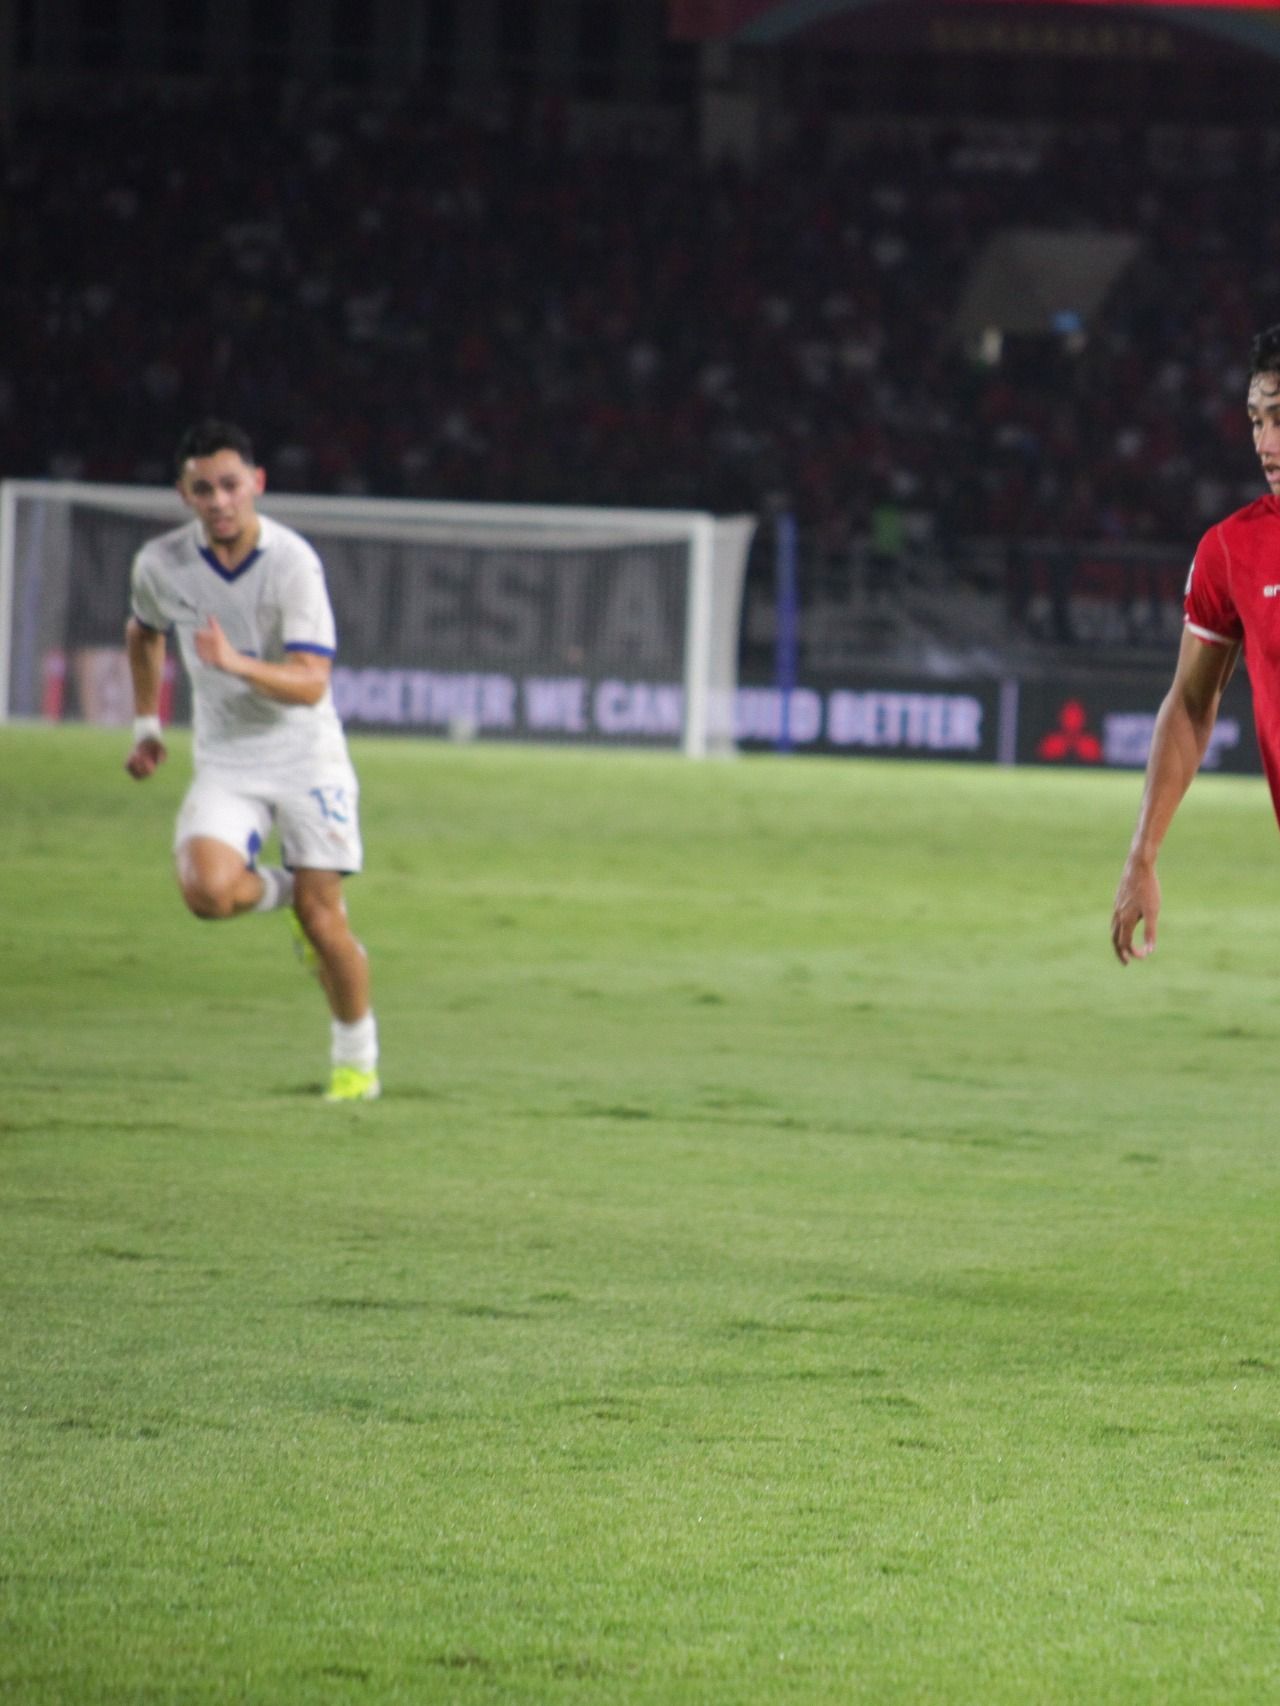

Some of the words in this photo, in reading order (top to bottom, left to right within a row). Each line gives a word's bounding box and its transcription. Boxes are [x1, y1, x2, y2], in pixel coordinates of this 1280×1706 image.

[334, 667, 517, 728] OGETHER
[525, 676, 588, 732] WE
[828, 689, 983, 750] BETTER
